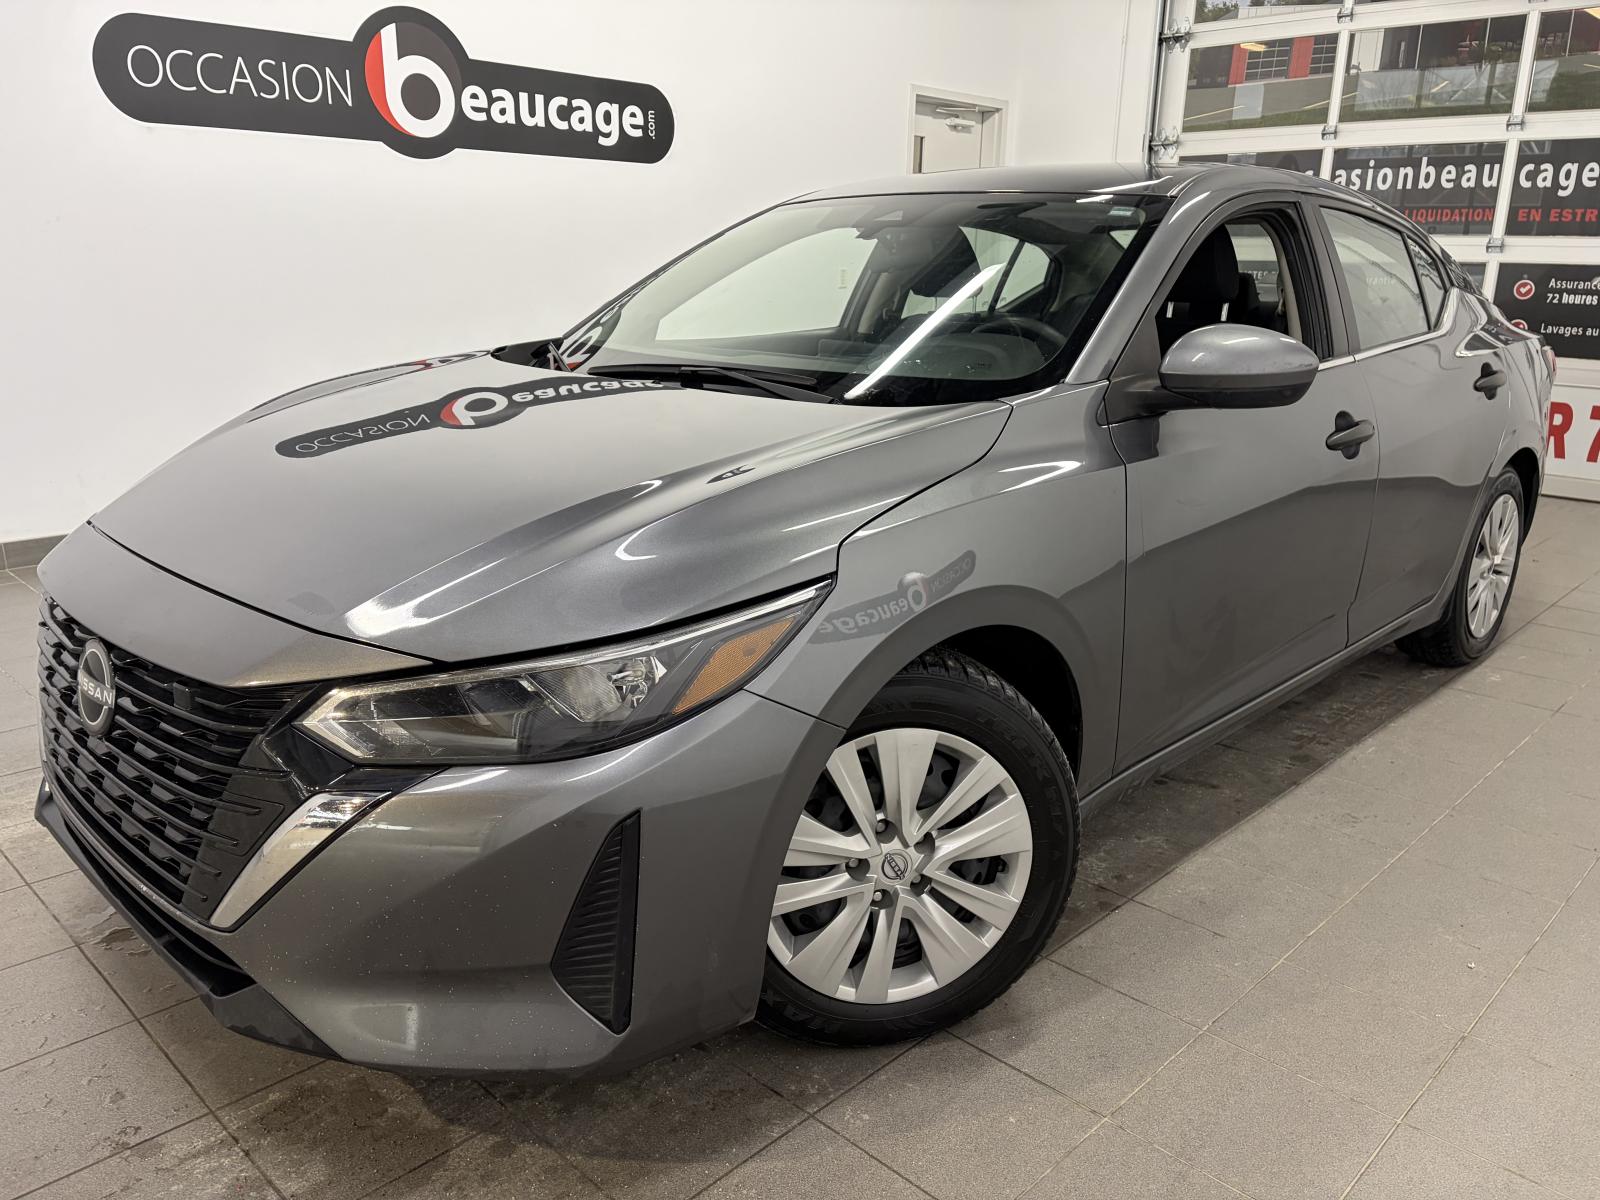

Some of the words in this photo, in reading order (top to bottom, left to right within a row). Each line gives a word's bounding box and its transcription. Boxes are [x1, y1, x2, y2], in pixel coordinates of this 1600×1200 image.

[126, 44, 353, 107] OCCASION
[1518, 208, 1542, 222] EN
[1550, 208, 1599, 222] ESTR
[1546, 293, 1560, 303] 72
[1540, 323, 1583, 337] Lavages
[1586, 327, 1600, 337] au
[80, 672, 113, 706] ISSAN
